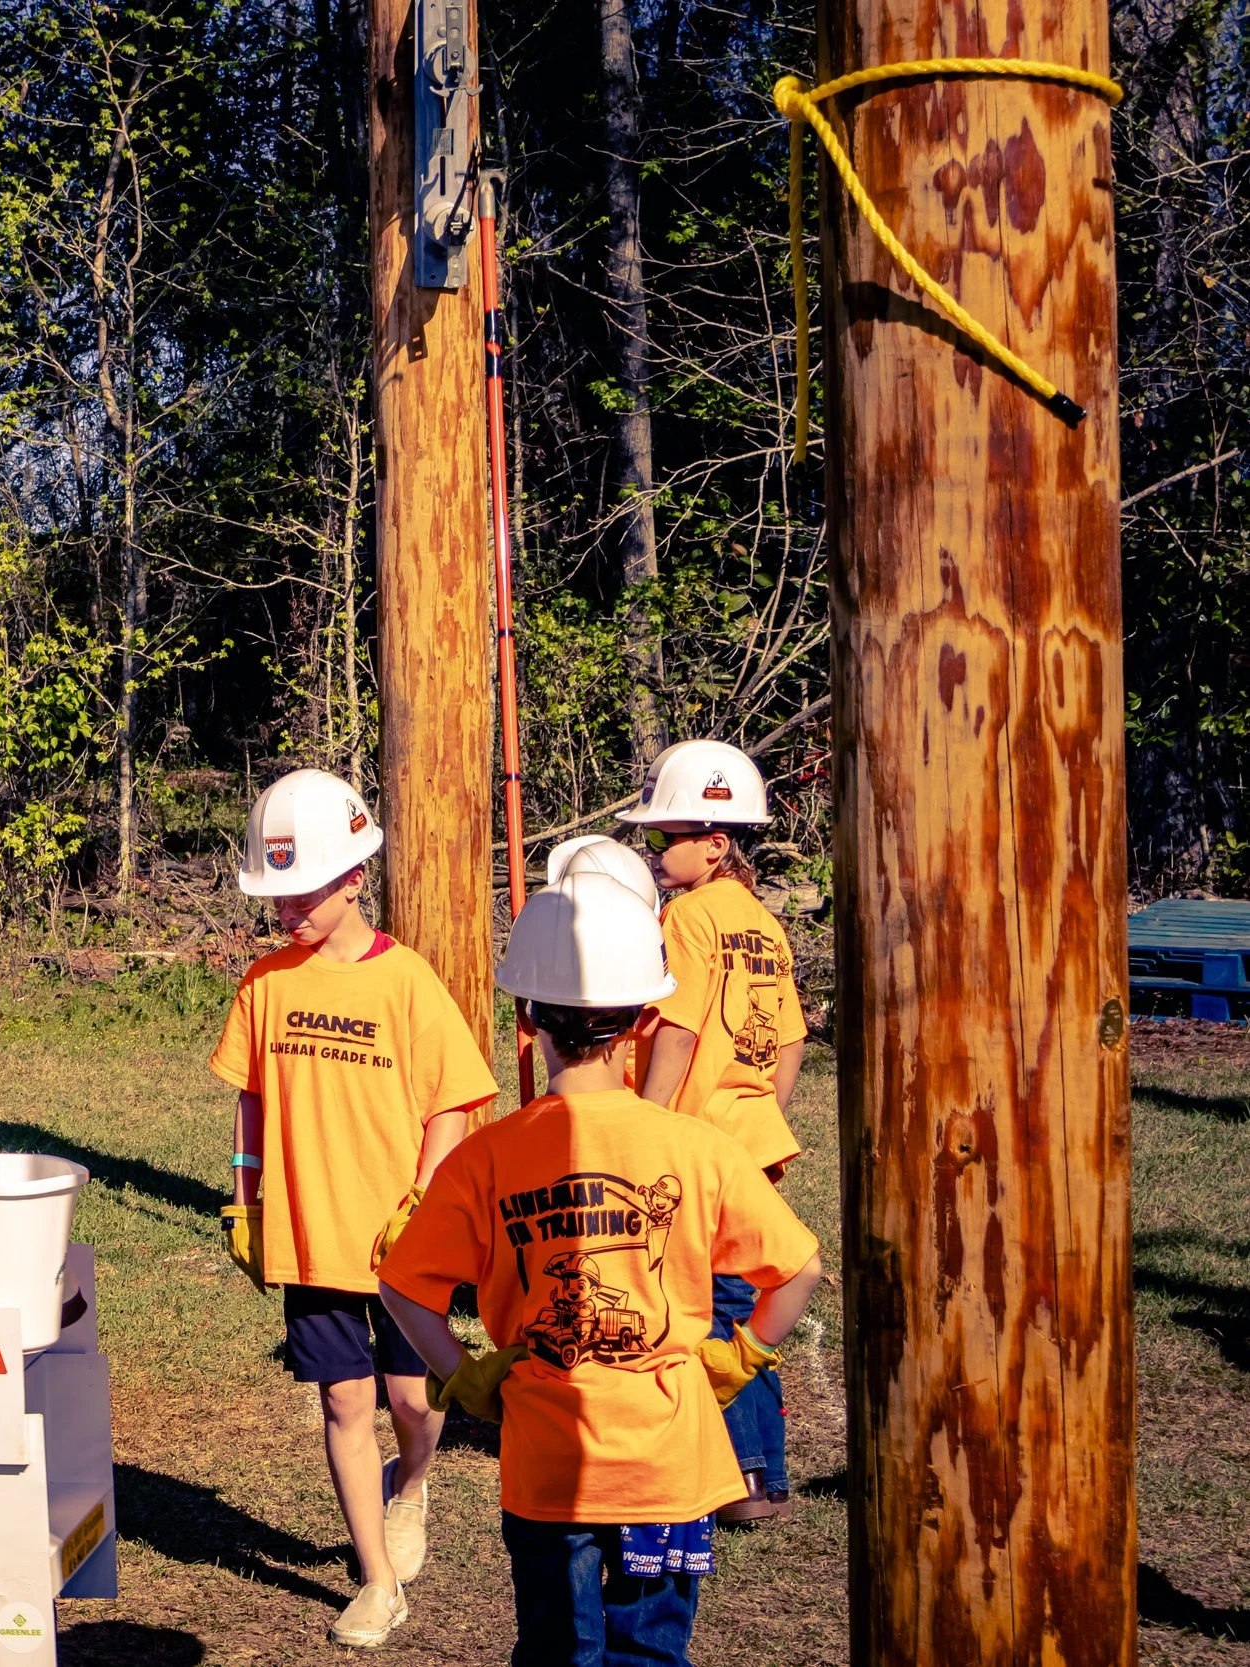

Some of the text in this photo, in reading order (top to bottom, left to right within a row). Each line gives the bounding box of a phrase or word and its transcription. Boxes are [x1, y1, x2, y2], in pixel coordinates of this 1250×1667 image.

[286, 1010, 377, 1039] CHANCE
[270, 1042, 393, 1069] LINEMAN GRADE KID
[499, 1181, 605, 1223] LINEMAN
[506, 1210, 643, 1248] IN TRAINING
[623, 1551, 664, 1565] Wagner
[629, 1562, 662, 1574] Smith
